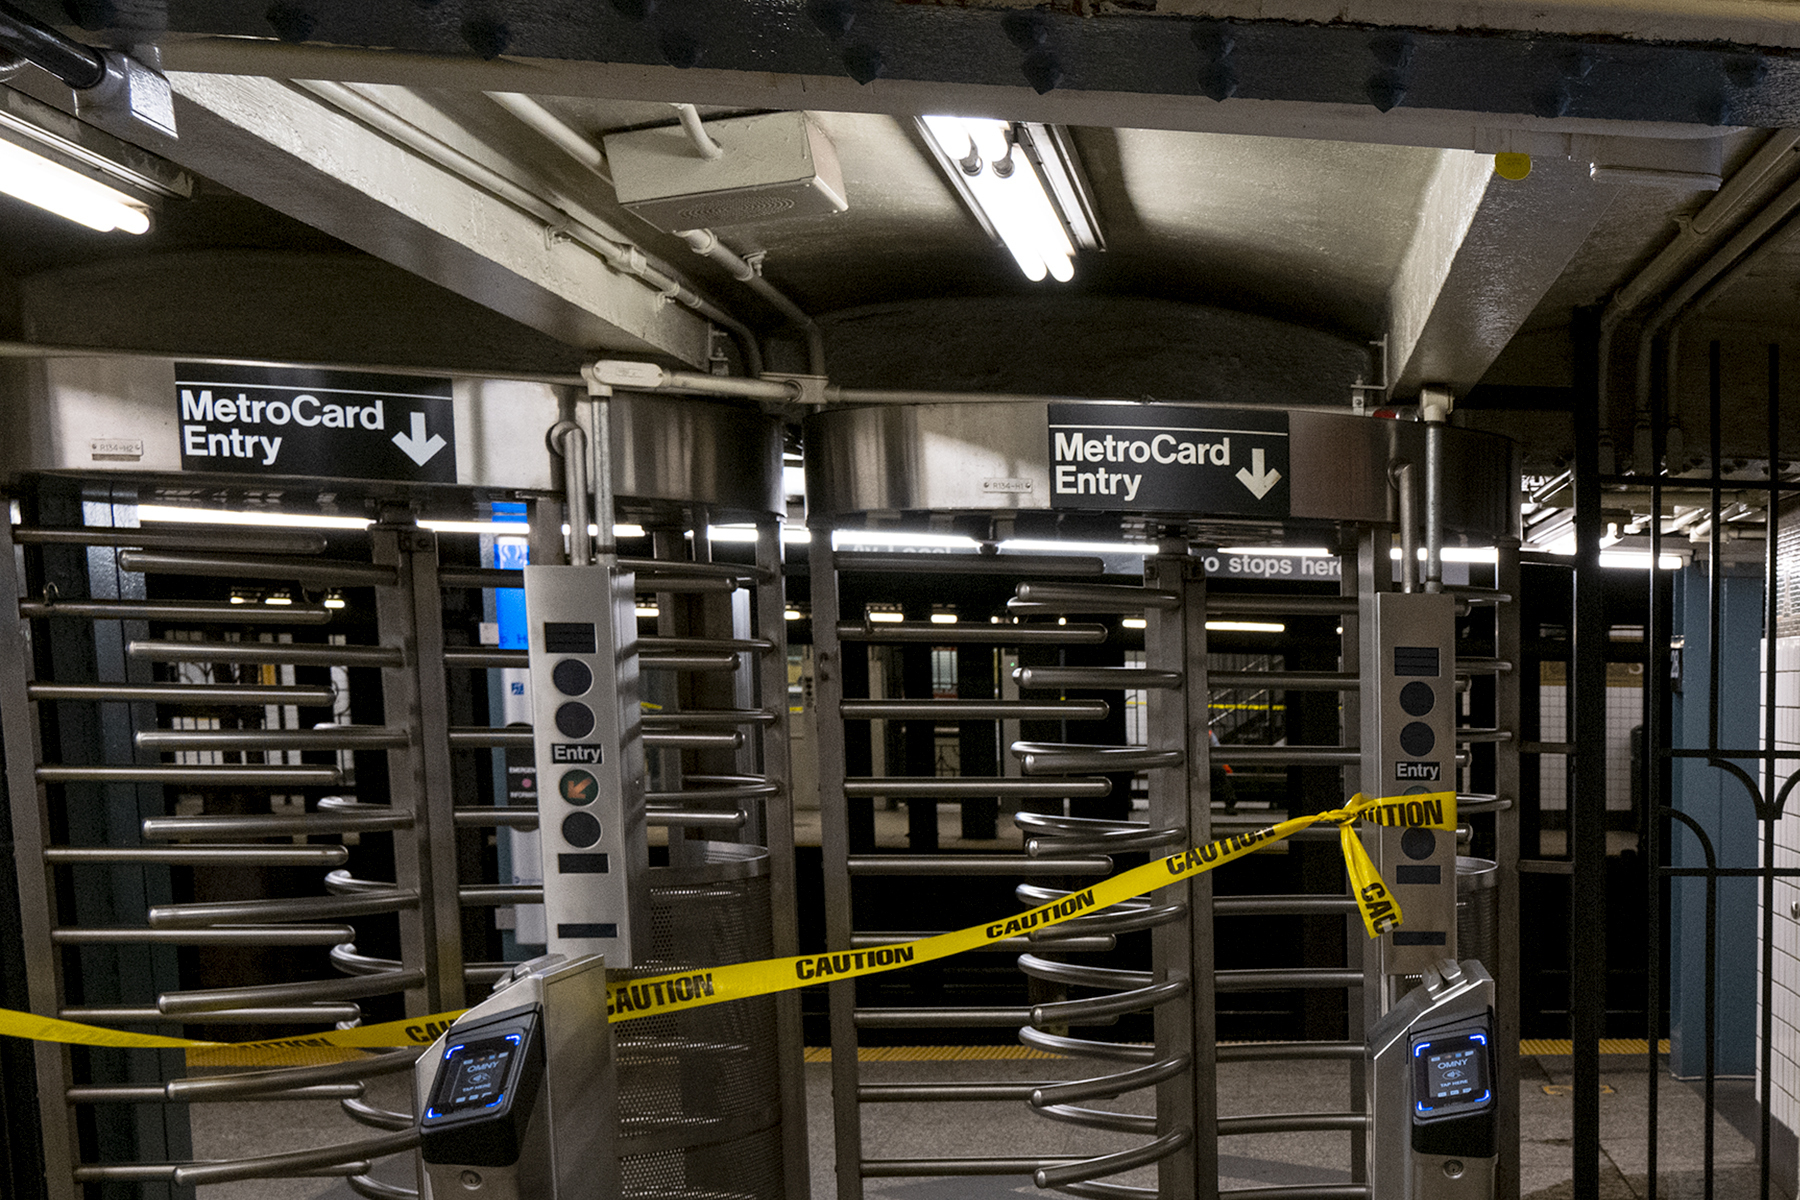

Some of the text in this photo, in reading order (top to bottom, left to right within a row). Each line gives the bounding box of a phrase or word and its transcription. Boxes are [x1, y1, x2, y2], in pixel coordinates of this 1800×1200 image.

[181, 389, 385, 430] MetroCard
[184, 424, 282, 466] Entry
[1055, 432, 1230, 466] MetroCard
[1056, 465, 1142, 501] Entry
[1229, 555, 1293, 577] stops
[554, 745, 601, 763] Entry
[1397, 763, 1439, 780] Entry
[795, 946, 914, 980] CAUTION
[986, 889, 1095, 939] CAUTION
[467, 1060, 499, 1072] OMNY
[1437, 1058, 1468, 1069] OMNY
